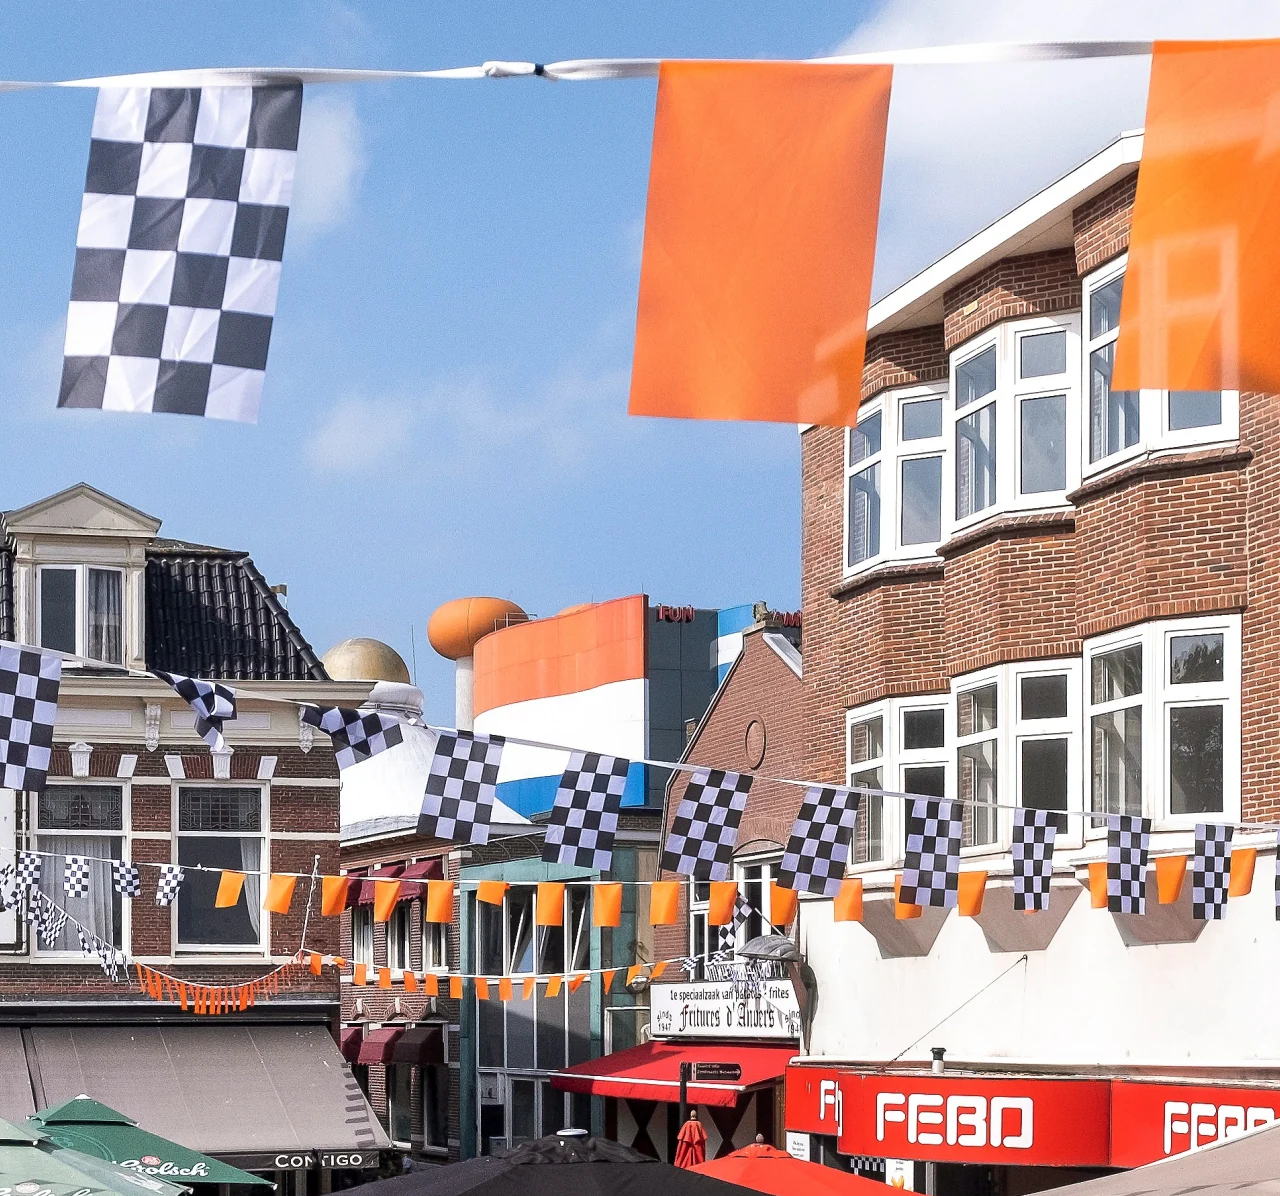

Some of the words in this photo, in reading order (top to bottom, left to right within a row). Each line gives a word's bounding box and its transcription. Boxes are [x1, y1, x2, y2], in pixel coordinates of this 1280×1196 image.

[657, 604, 695, 624] FUN
[679, 988, 720, 1002] speciaalzaak
[769, 986, 789, 999] frites
[658, 1023, 672, 1032] 1947
[678, 1004, 721, 1032] Fritures
[876, 1093, 1035, 1149] FEBO
